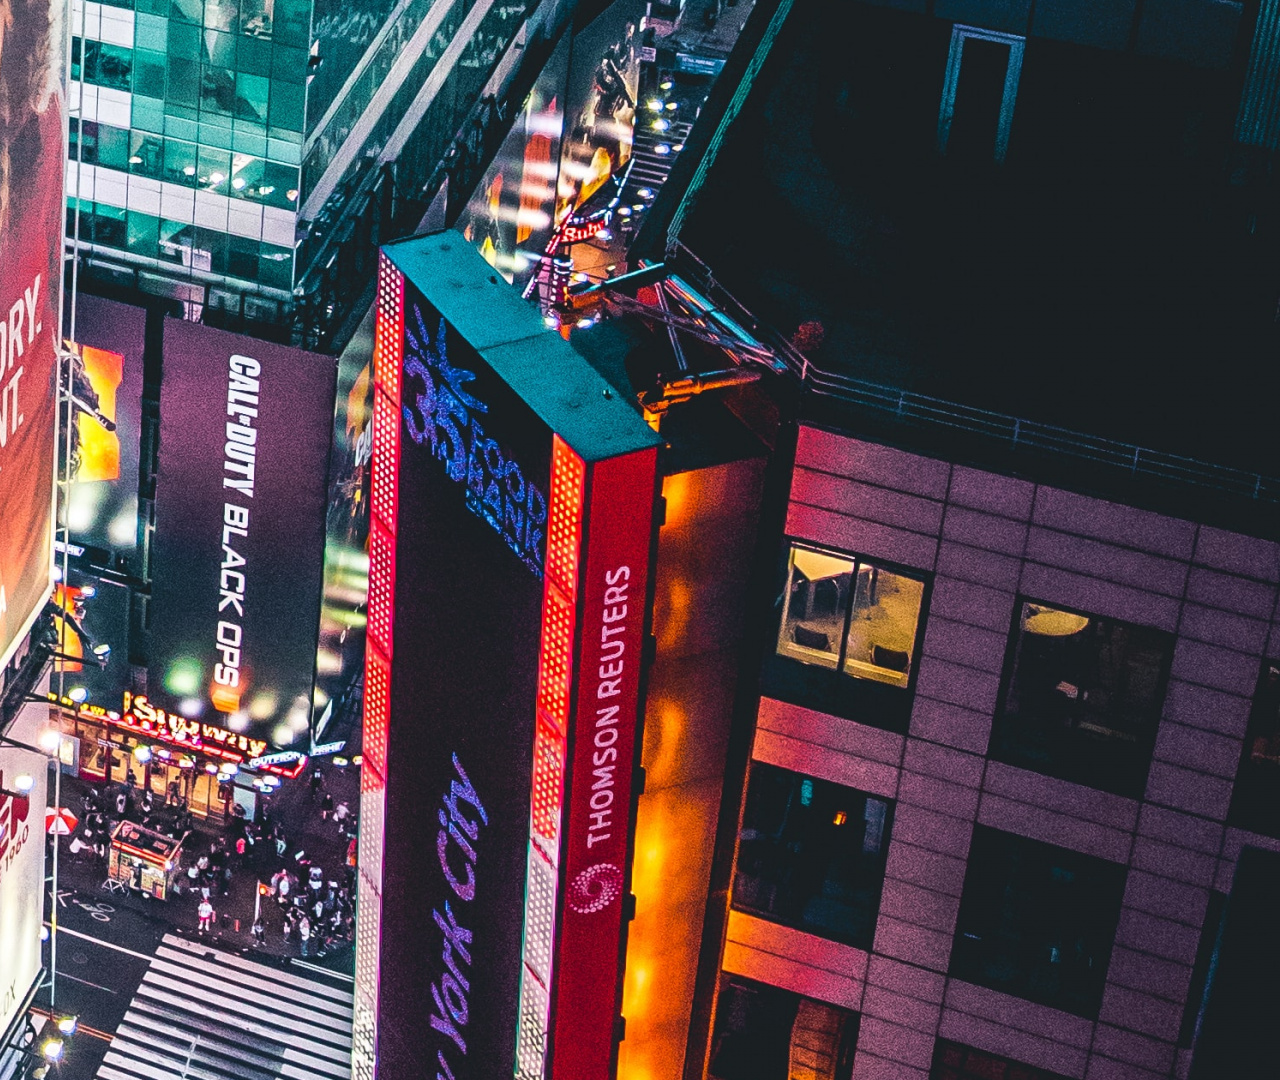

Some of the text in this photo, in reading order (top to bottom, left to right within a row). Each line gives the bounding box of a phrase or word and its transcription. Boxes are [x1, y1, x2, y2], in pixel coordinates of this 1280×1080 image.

[228, 354, 261, 420] CALL
[223, 420, 257, 498] DUTY
[218, 502, 249, 617] BLACK
[214, 620, 242, 688] OPS
[587, 565, 631, 849] THOMSON REUTERS
[3, 824, 29, 872] 1960
[436, 751, 489, 902] City
[430, 899, 473, 1055] York
